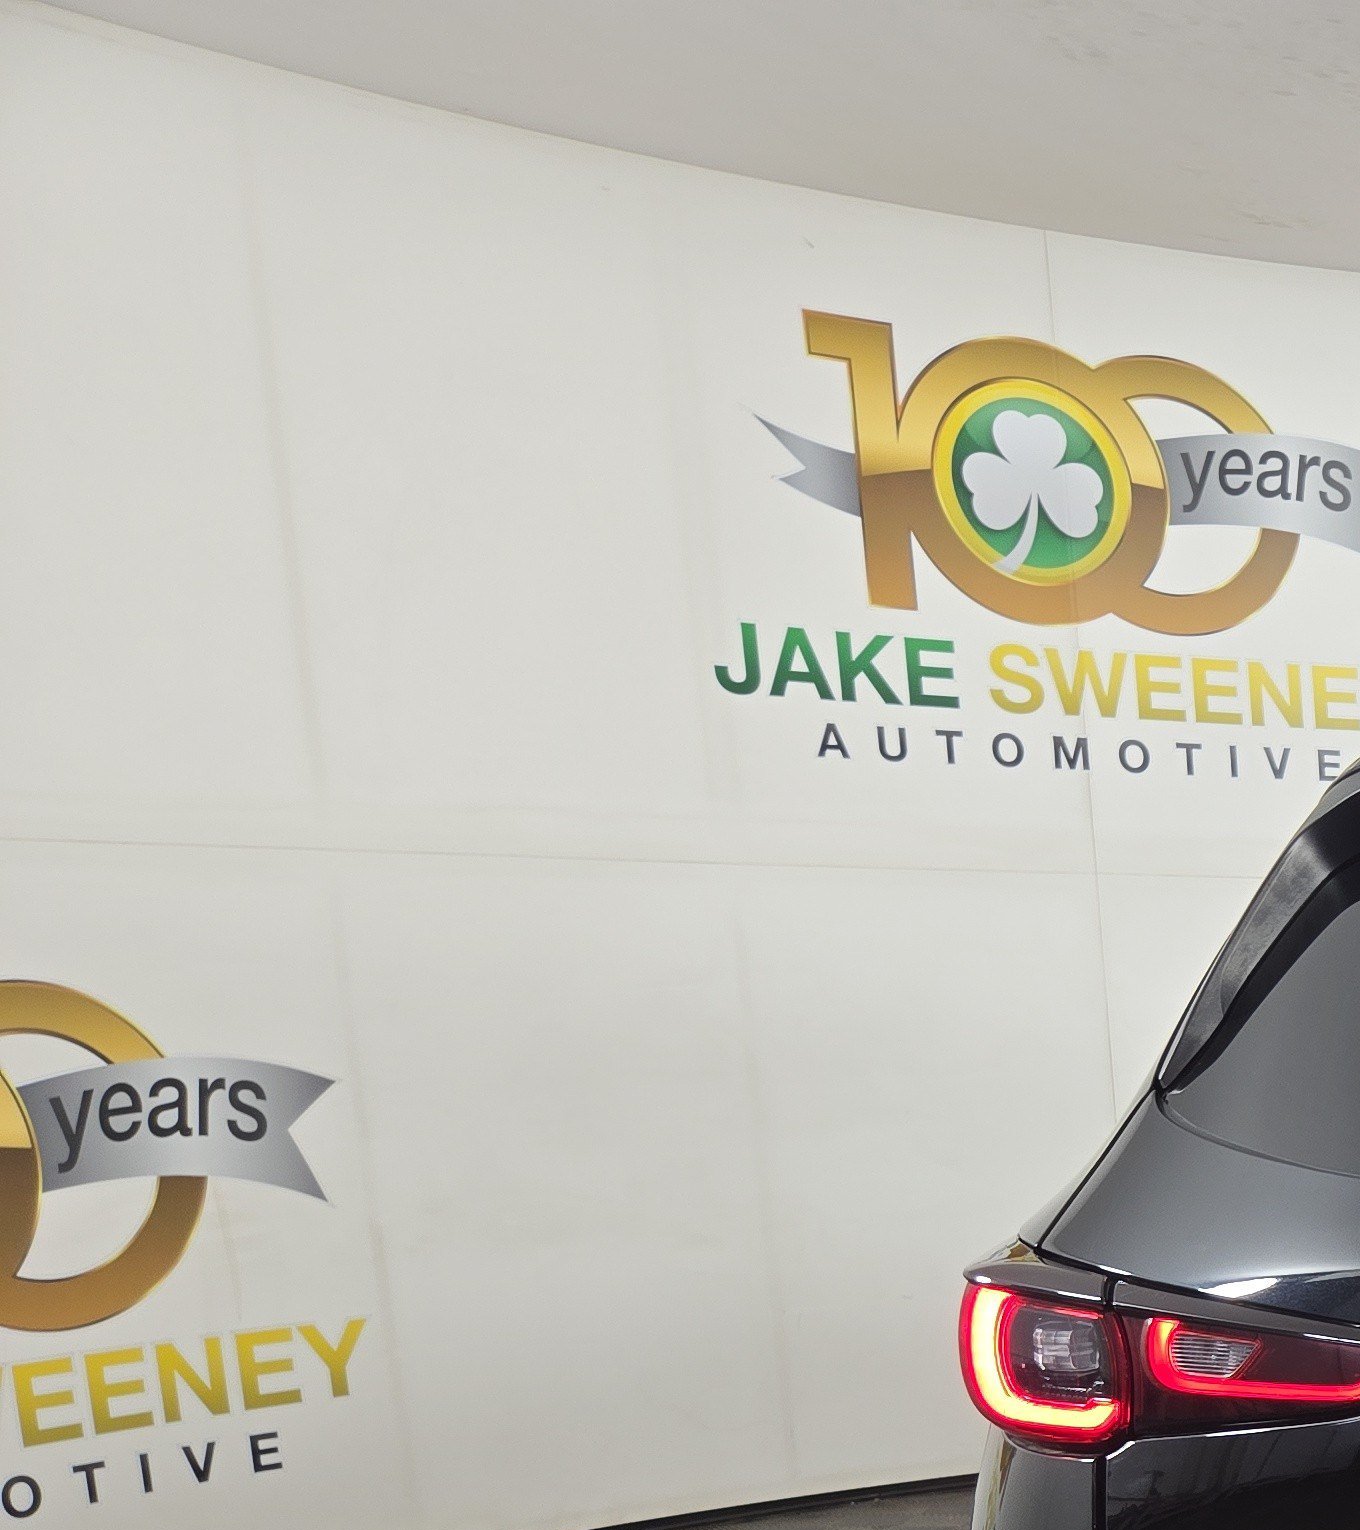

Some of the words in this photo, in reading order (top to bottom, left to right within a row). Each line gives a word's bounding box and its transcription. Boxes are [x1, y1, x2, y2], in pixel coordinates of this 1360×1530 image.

[1180, 449, 1353, 512] years
[714, 621, 960, 709] JAKE
[817, 722, 1341, 781] AUTOMOTIVE
[49, 1077, 268, 1174] years
[0, 1319, 366, 1447] EENEY
